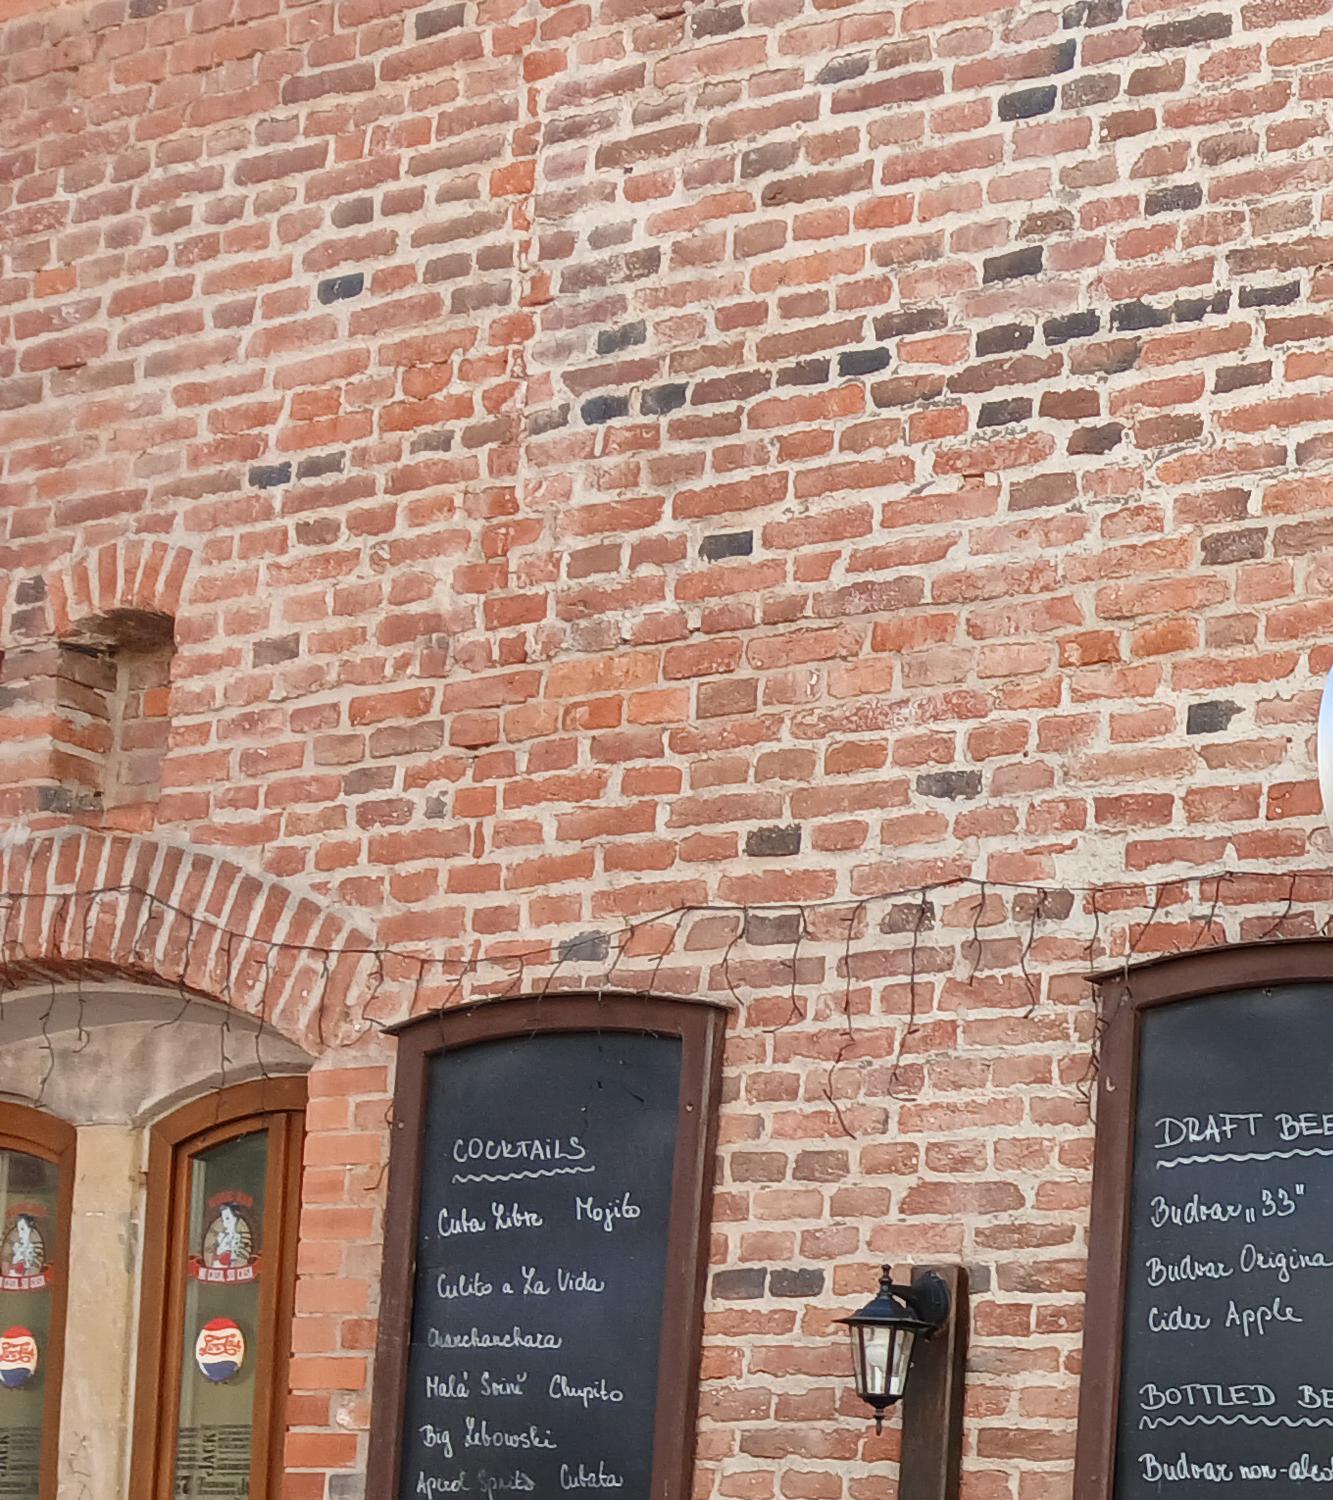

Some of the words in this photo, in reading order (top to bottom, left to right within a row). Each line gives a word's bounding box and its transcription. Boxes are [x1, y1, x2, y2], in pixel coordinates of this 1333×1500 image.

[1153, 1113, 1263, 1149] DRAFT
[438, 1208, 486, 1236] Cuba
[491, 1202, 543, 1230] Libre
[575, 1192, 641, 1232] Mojito
[1150, 1196, 1241, 1228] Budvar
[502, 1282, 514, 1293] a
[557, 1268, 605, 1292] Vida
[1146, 1257, 1233, 1287] Budvar
[1148, 1304, 1211, 1332] Cider
[1225, 1298, 1303, 1337] Apple
[549, 1374, 624, 1408] Chupito
[1138, 1383, 1276, 1411] BOTTLED
[418, 1424, 453, 1458] Big
[464, 1416, 558, 1449] Lebowski
[1138, 1452, 1233, 1482] Budvar
